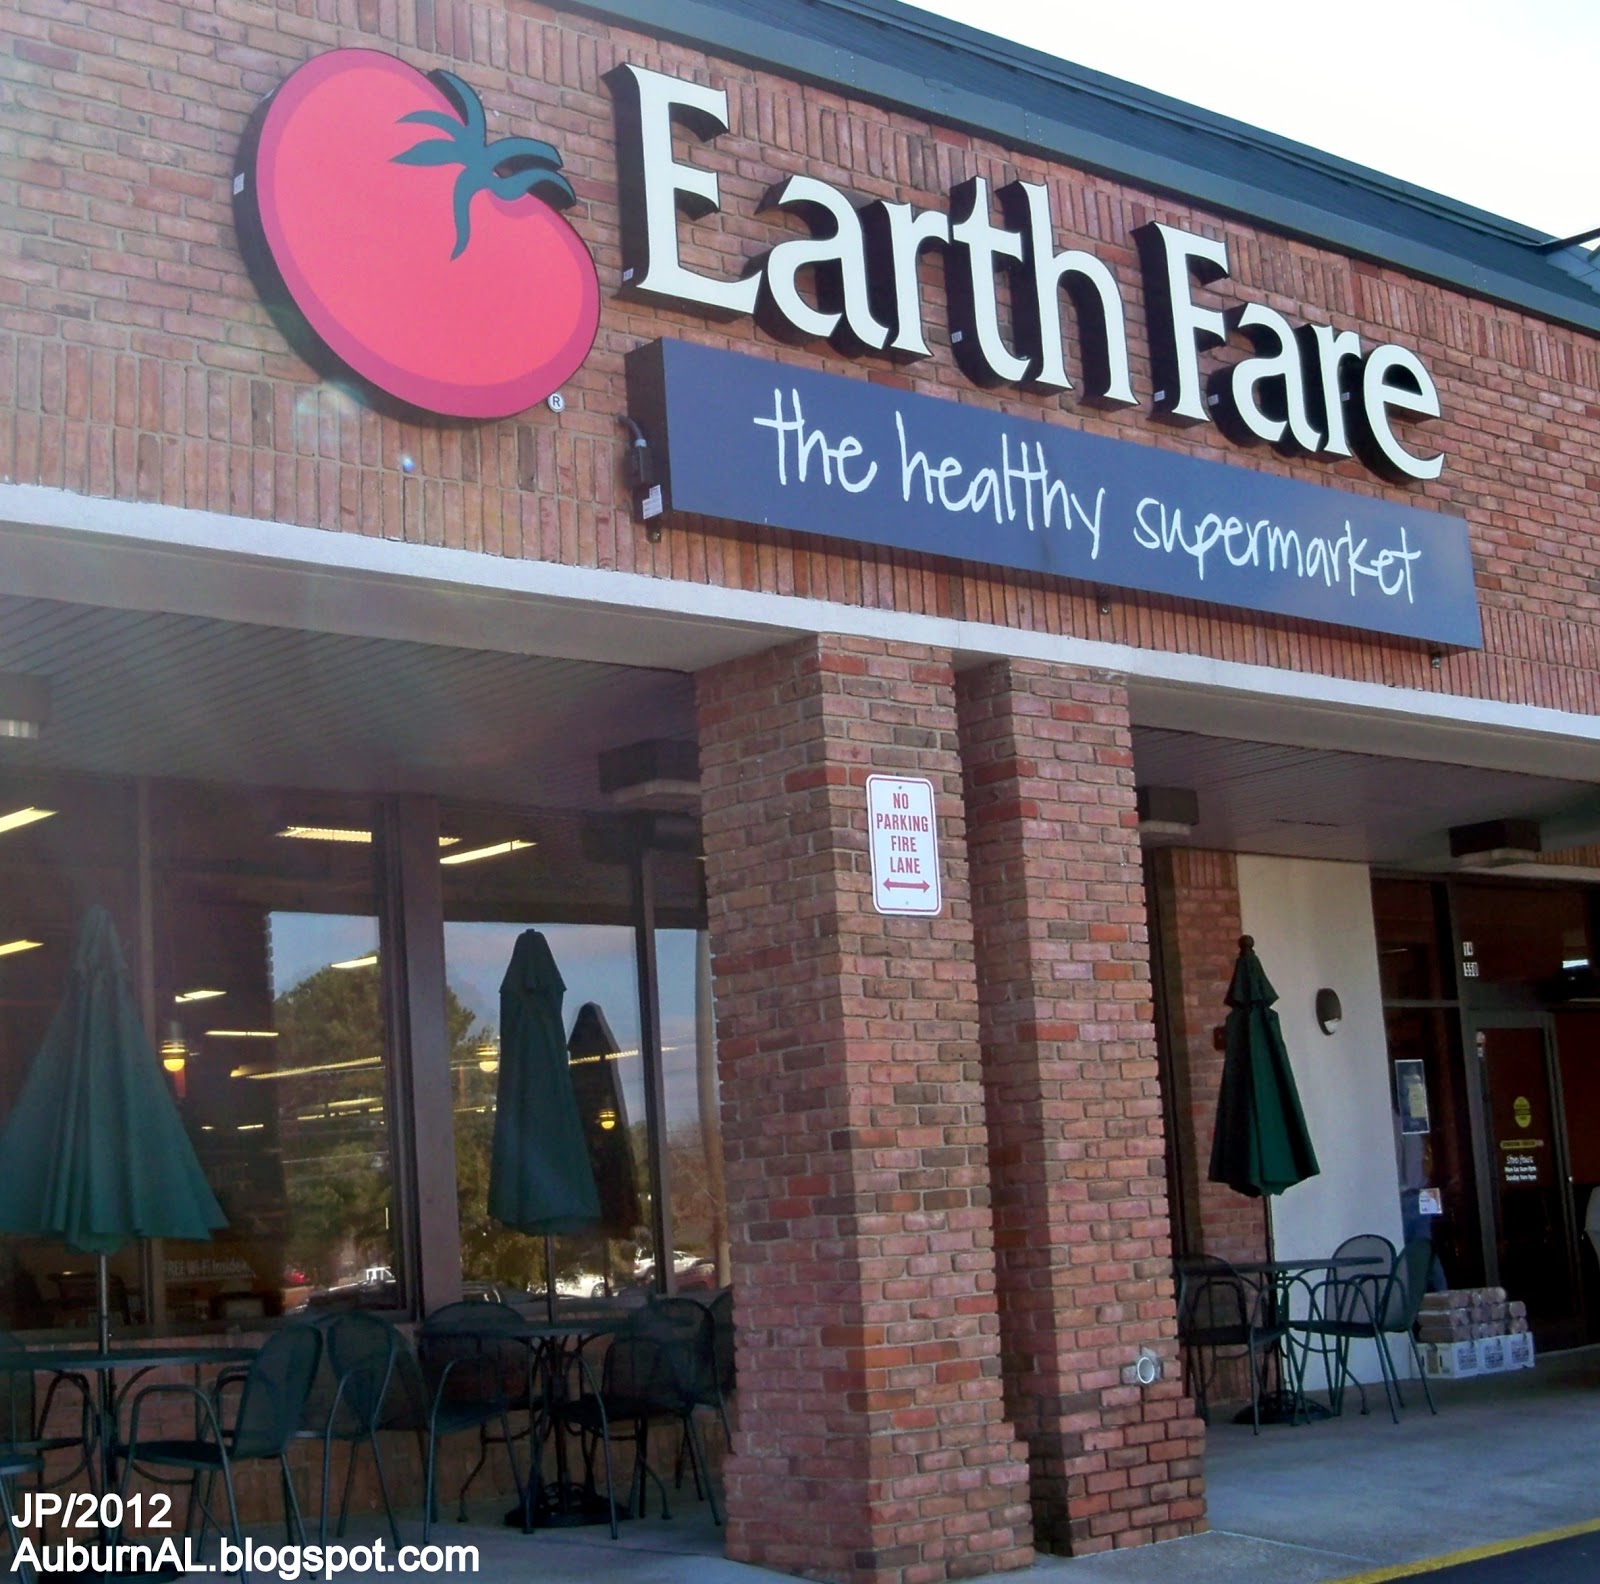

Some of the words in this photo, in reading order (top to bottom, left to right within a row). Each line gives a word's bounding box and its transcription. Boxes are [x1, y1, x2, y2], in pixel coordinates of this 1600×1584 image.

[625, 63, 1139, 405] Earth
[1152, 220, 1445, 480] Fare
[753, 388, 878, 493] the
[895, 411, 1106, 560] healthy
[1132, 496, 1421, 603] supermarket
[893, 792, 909, 810] NO
[876, 813, 929, 833] PARKING
[890, 835, 917, 853] FIRE
[890, 856, 921, 874] LANE
